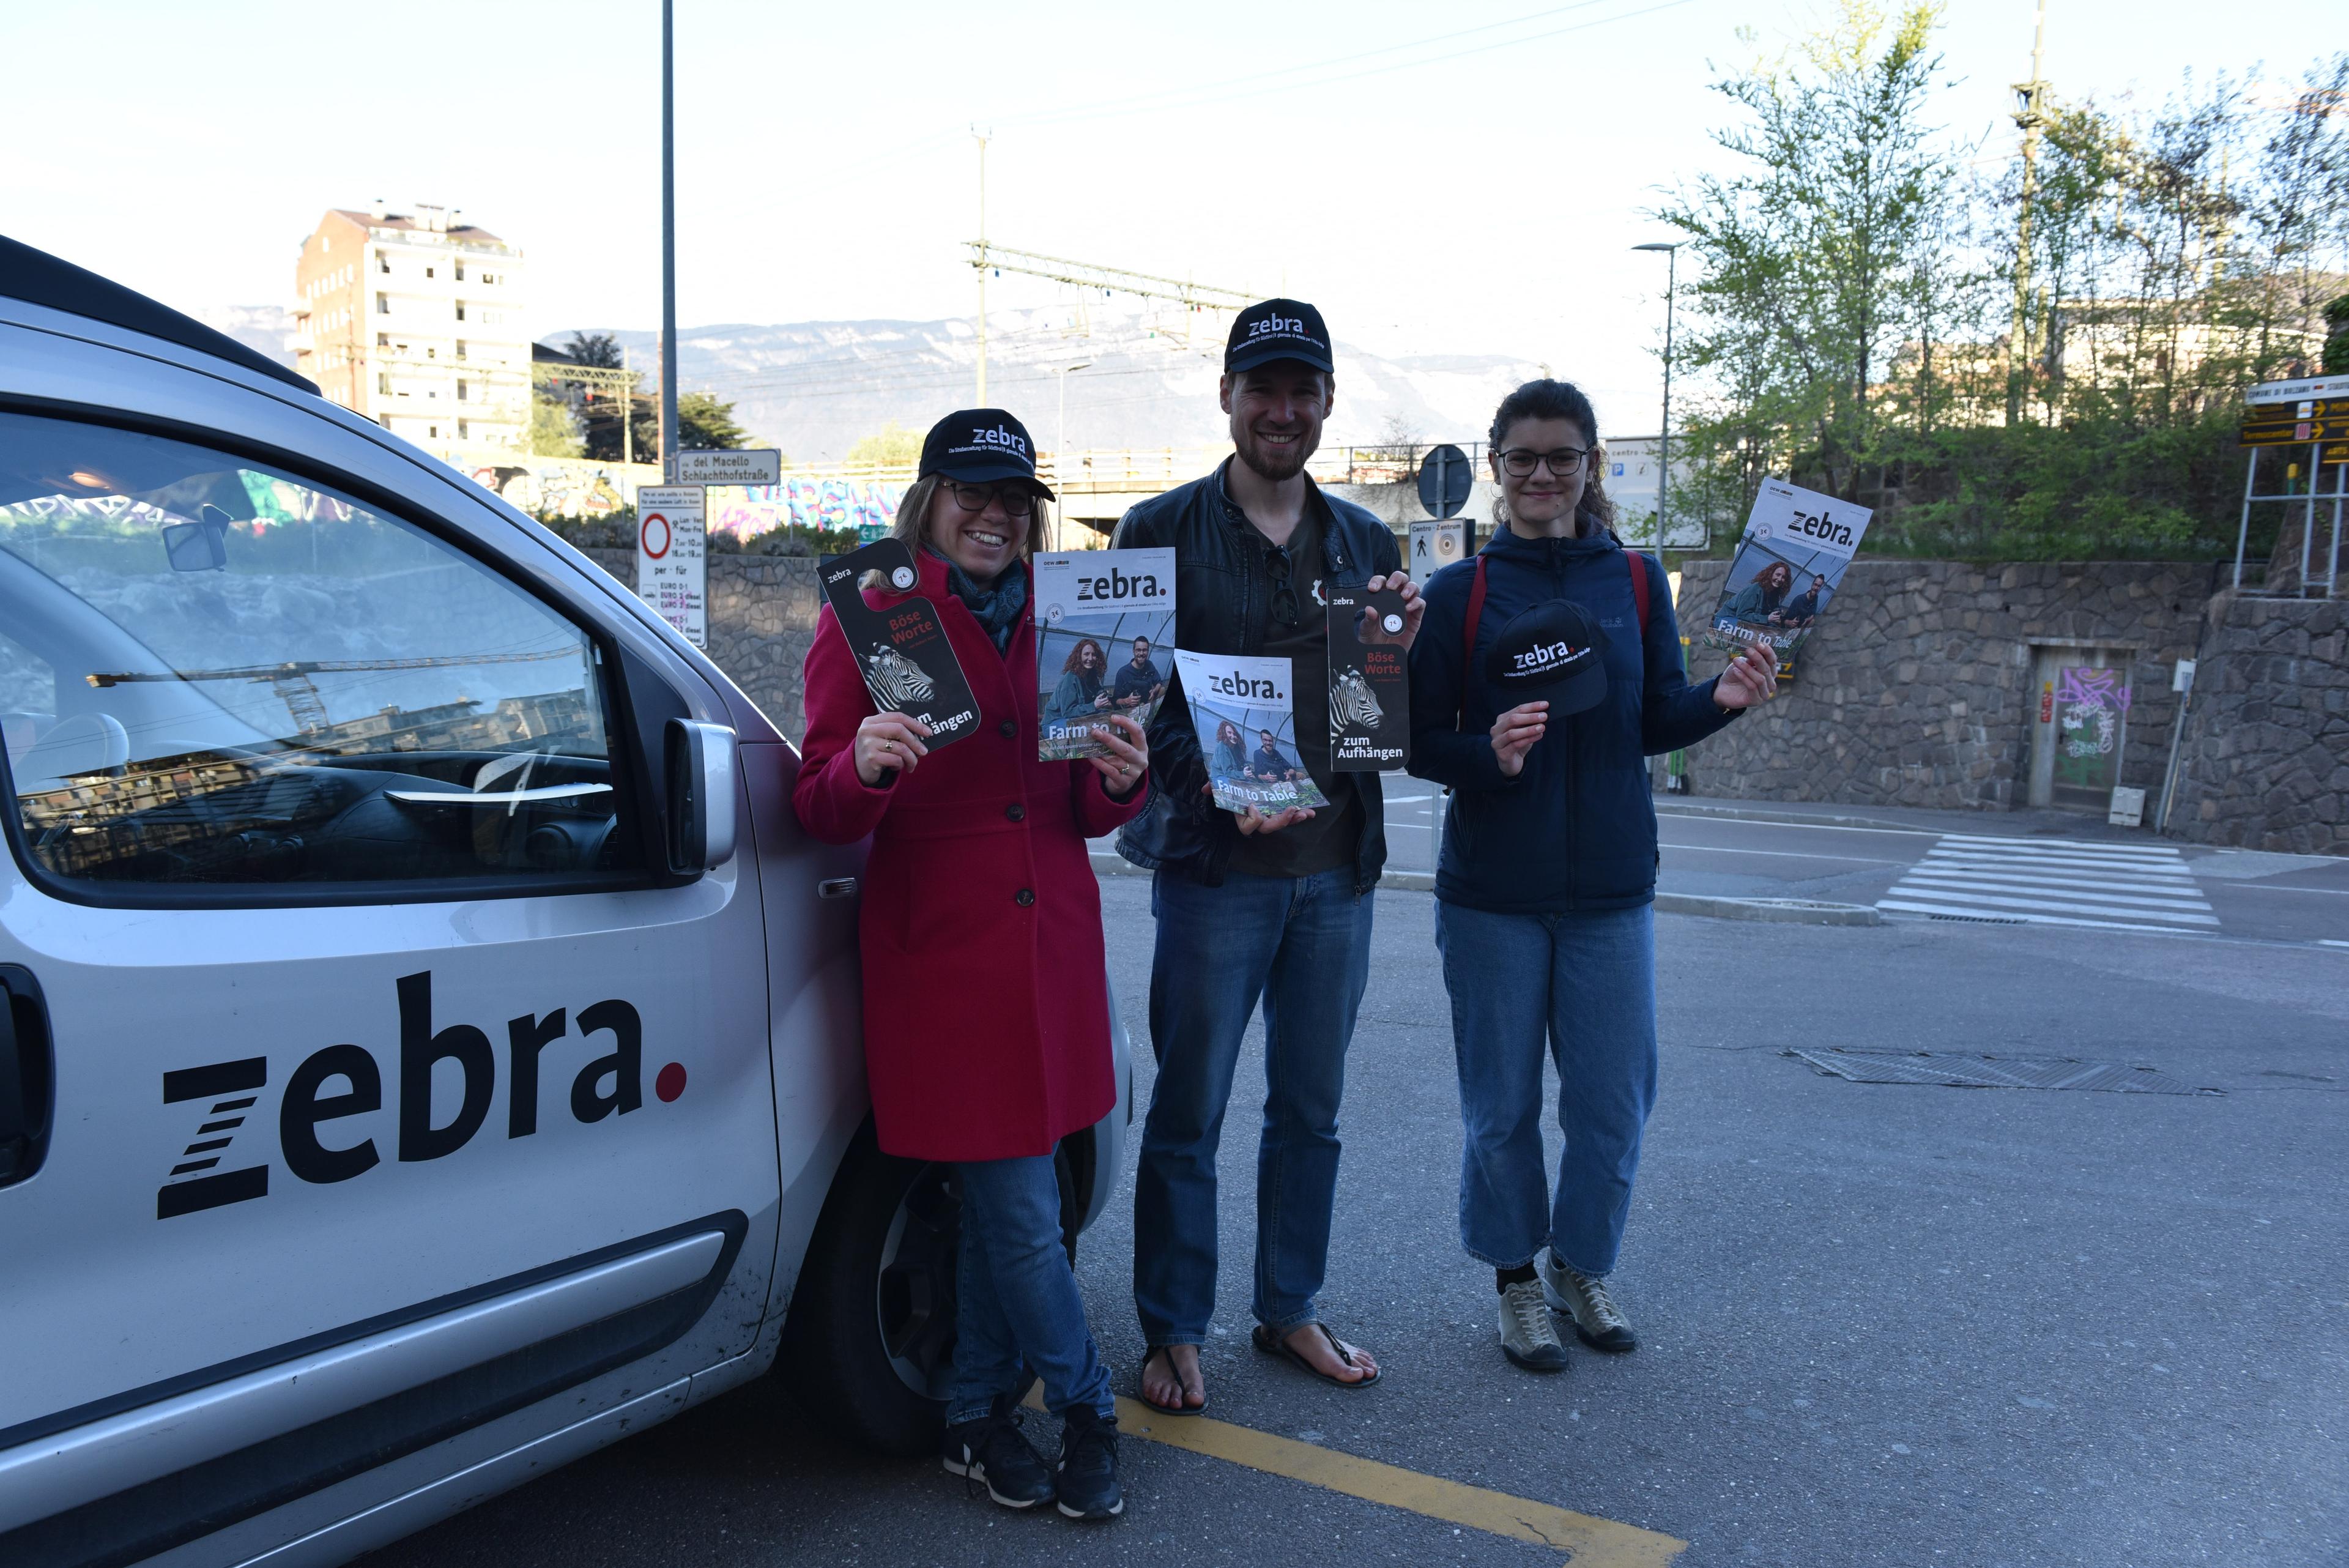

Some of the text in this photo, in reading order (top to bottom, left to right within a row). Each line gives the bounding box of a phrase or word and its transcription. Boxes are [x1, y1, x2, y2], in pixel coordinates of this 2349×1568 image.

[1249, 313, 1309, 336] zebra.
[973, 425, 1031, 456] zebra.
[694, 457, 708, 467] del
[713, 455, 749, 466] Macello
[682, 469, 768, 481] Schlachthofstraße
[1788, 511, 1853, 547] zebra.
[655, 567, 666, 576] per
[676, 565, 686, 574] für
[1077, 567, 1167, 601] zebra.
[889, 612, 921, 631] Böse
[1051, 610, 1059, 619] 3€
[891, 621, 933, 645] Worte
[1718, 620, 1754, 641] Farm
[1758, 632, 1772, 646] to
[1772, 636, 1792, 648] Table
[1367, 652, 1395, 663] Böse
[1513, 641, 1575, 669] zebra.
[1365, 664, 1401, 674] Worte
[1209, 671, 1283, 699] zebra.
[1048, 724, 1087, 740] Farm
[1343, 737, 1370, 746] zum
[1338, 746, 1403, 760] Aufhängen
[1217, 779, 1298, 801] Farm to Table
[157, 970, 688, 1221] zebra.
